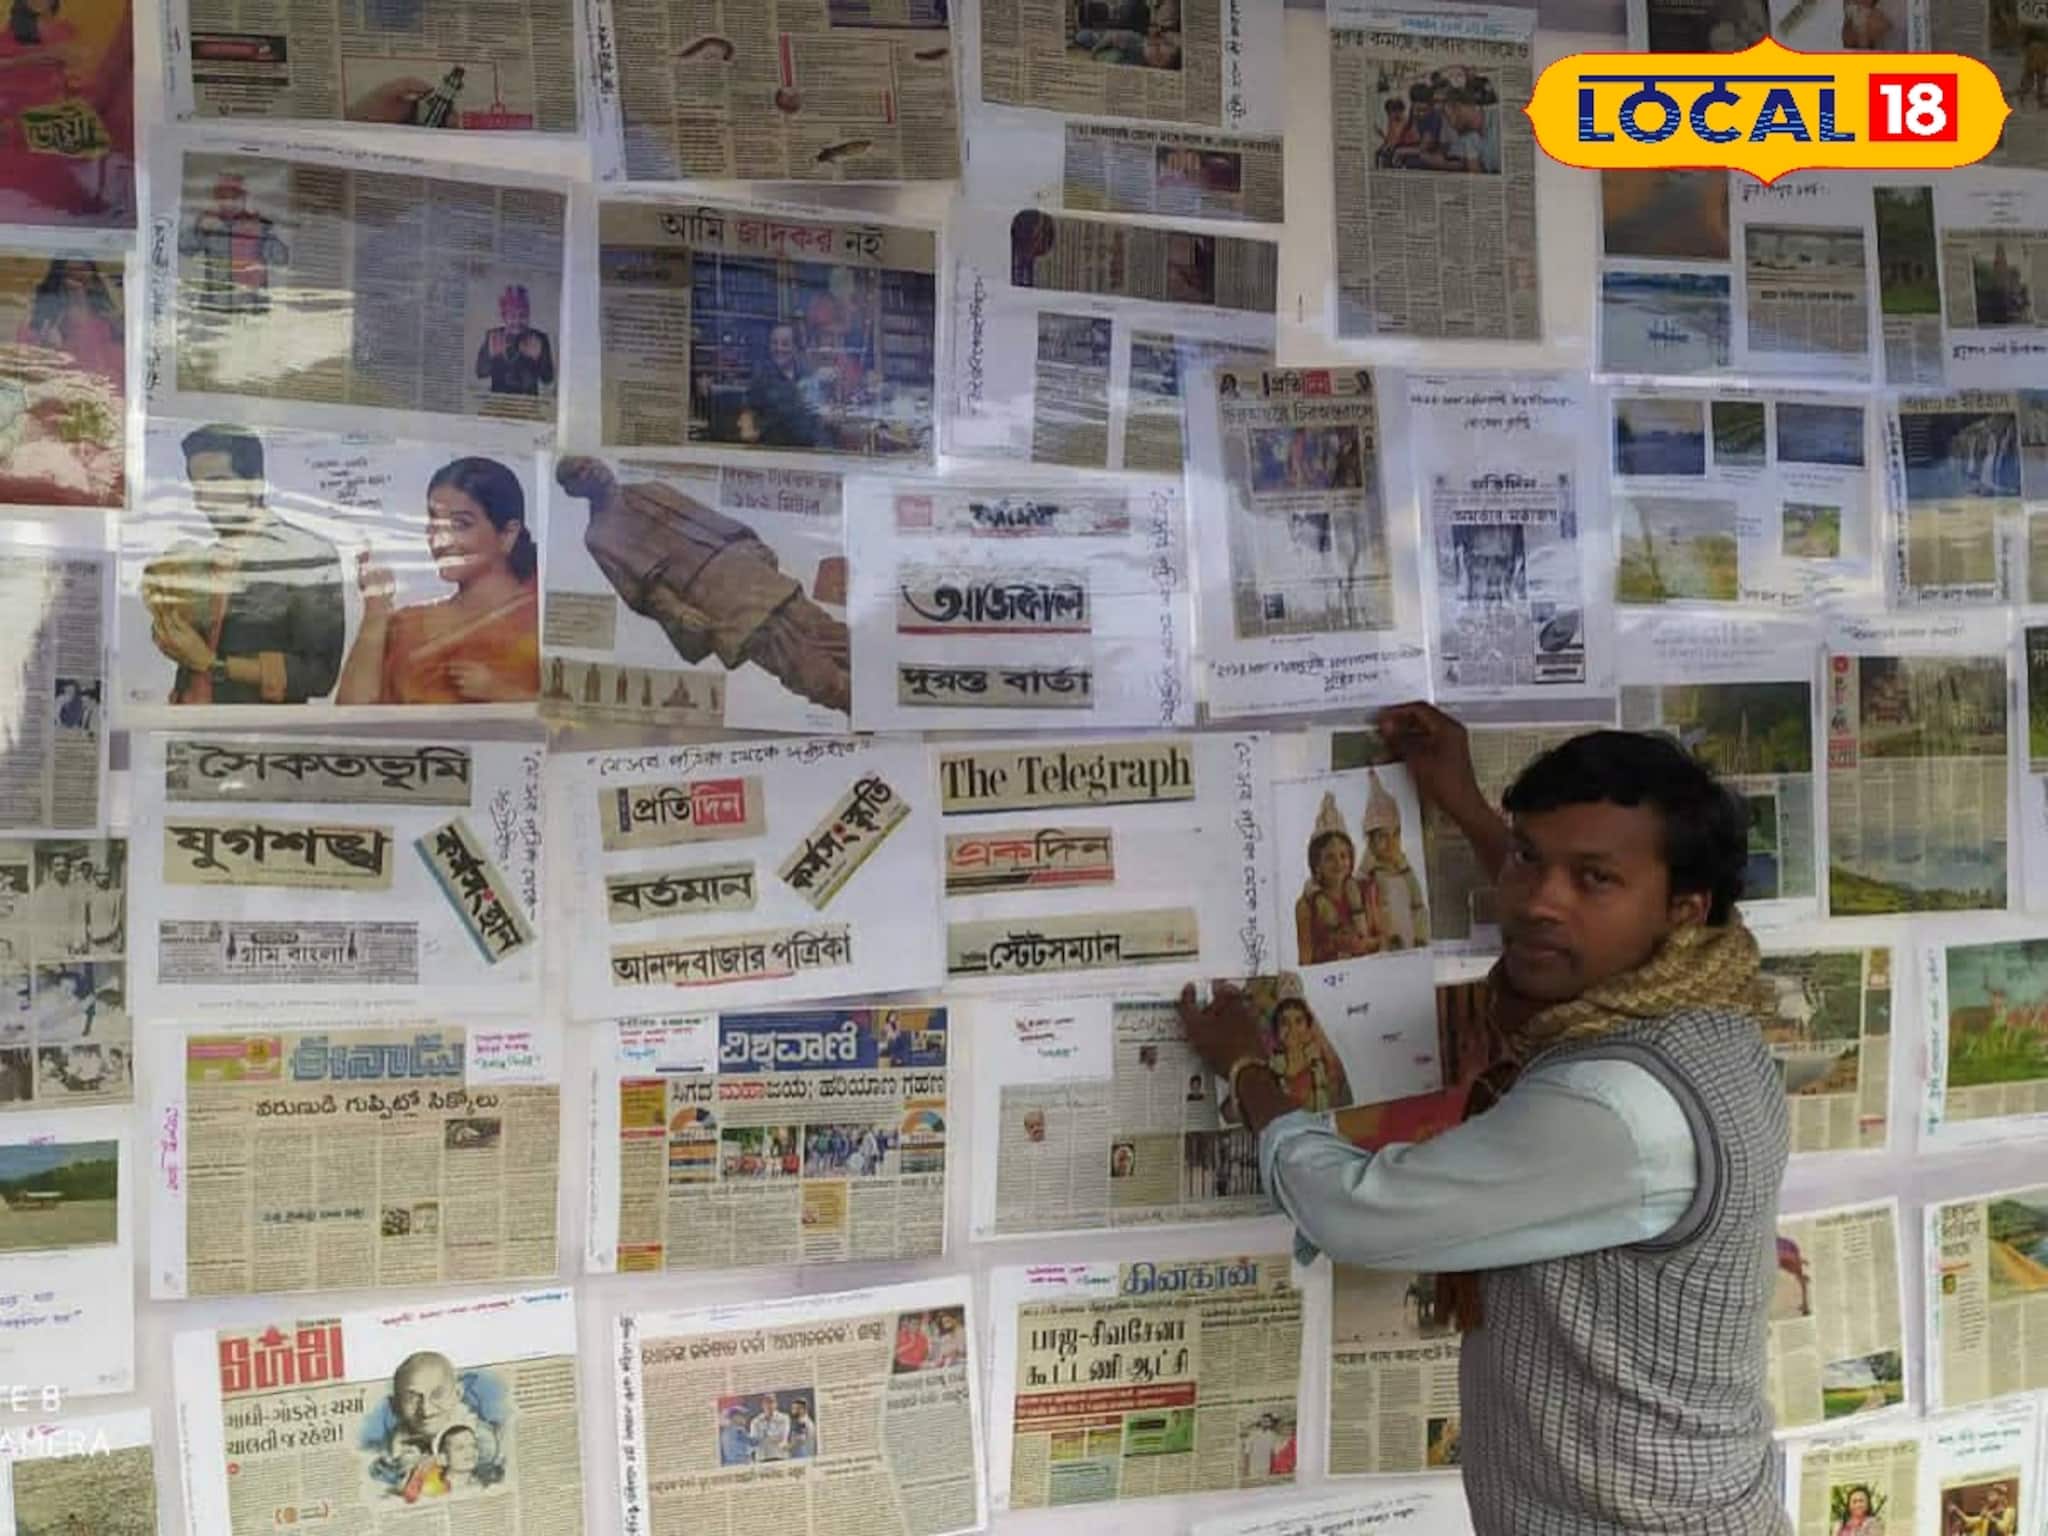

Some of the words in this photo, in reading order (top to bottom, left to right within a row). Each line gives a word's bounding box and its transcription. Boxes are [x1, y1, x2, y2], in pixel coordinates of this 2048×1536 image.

[658, 207, 724, 243] আমি
[846, 228, 884, 261] নই
[901, 583, 1084, 622] আজকাল
[1003, 666, 1093, 695] বার্তা
[191, 743, 470, 790] সৈকতভূমি
[940, 757, 1008, 799] The
[1018, 747, 1192, 799] Telegraph
[632, 783, 744, 826] প্রতিদিন
[951, 827, 1111, 869] একদিন
[608, 871, 754, 911] বর্তমান
[611, 940, 767, 985] আনন্দবাজার
[773, 924, 852, 970] পত্রিকা
[990, 930, 1121, 968] স্টেটসম্যান
[288, 1033, 465, 1081] ఈనాడు
[1123, 1257, 1257, 1297] தினகரன்
